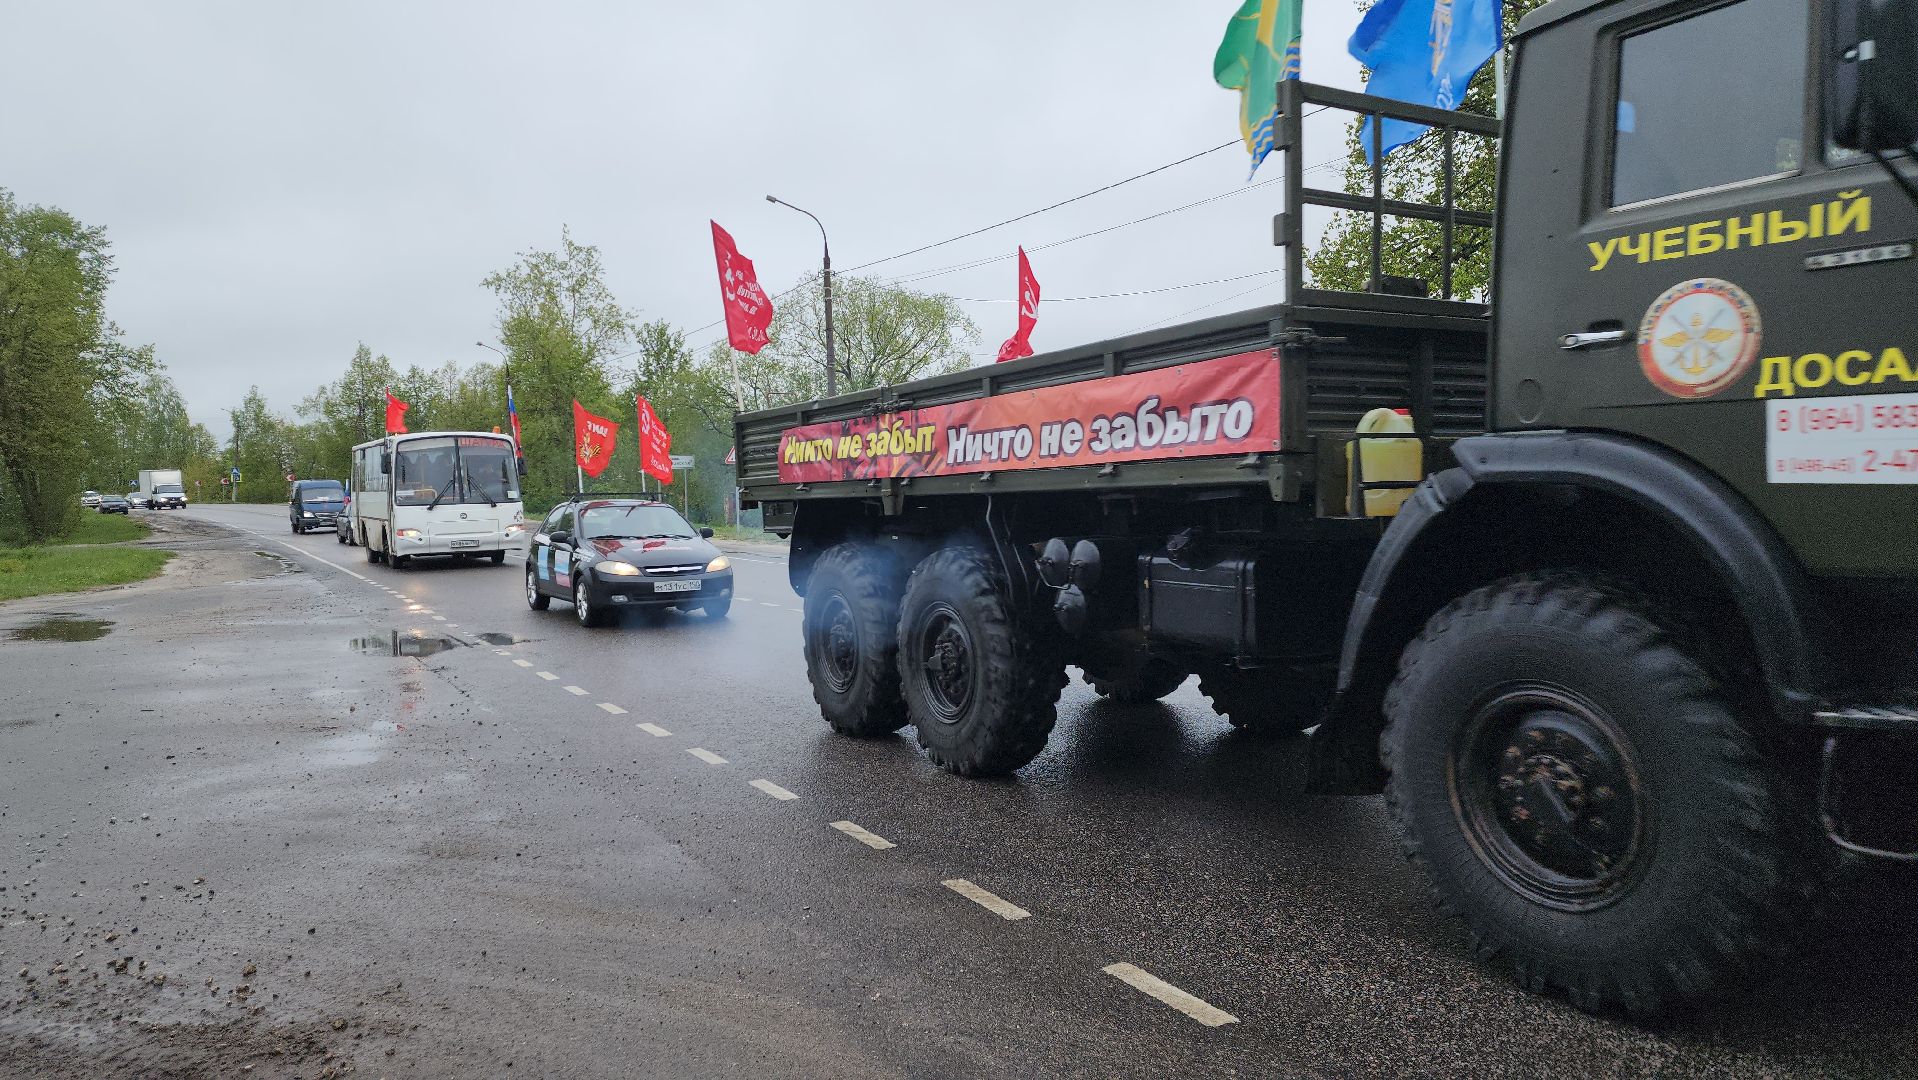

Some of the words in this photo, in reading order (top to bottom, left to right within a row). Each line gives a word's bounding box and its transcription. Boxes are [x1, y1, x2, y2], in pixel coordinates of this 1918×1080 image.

[1587, 188, 1872, 272] УЧЕБНЫЙ
[1754, 346, 1918, 398] ДОСА
[836, 433, 863, 459] не
[946, 426, 1033, 465] Ничто
[1039, 421, 1083, 457] не
[1090, 397, 1254, 454] забыто
[1776, 408, 1791, 432] 8
